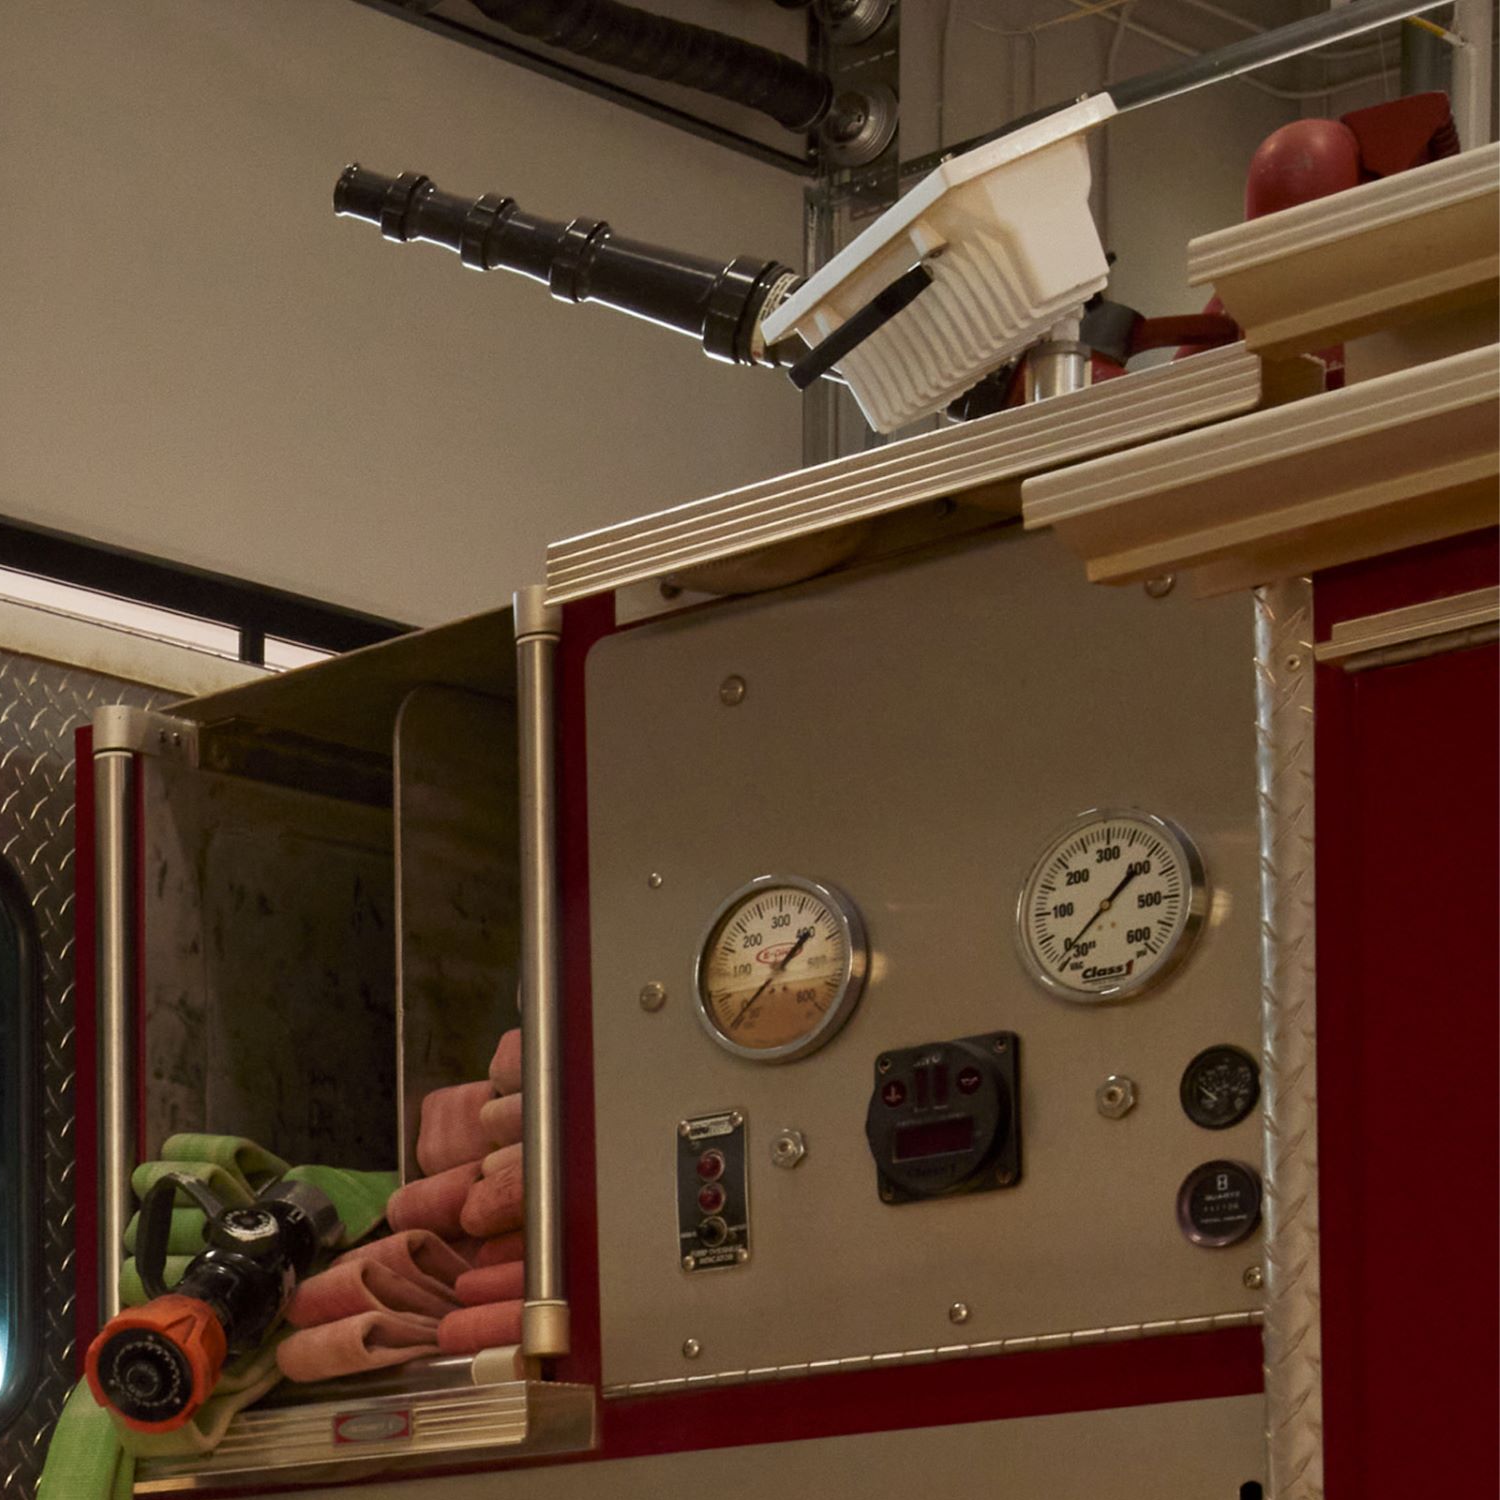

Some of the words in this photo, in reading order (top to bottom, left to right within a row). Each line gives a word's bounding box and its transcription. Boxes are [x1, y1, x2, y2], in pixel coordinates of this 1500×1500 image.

[1096, 846, 1121, 863] 300
[1126, 860, 1151, 877] 400
[1066, 869, 1090, 886] 200
[1137, 891, 1162, 908] 500
[1053, 902, 1074, 918] 100
[772, 914, 791, 928] 300
[743, 934, 762, 948] 200
[1127, 926, 1151, 944] 600
[734, 964, 751, 976] 100
